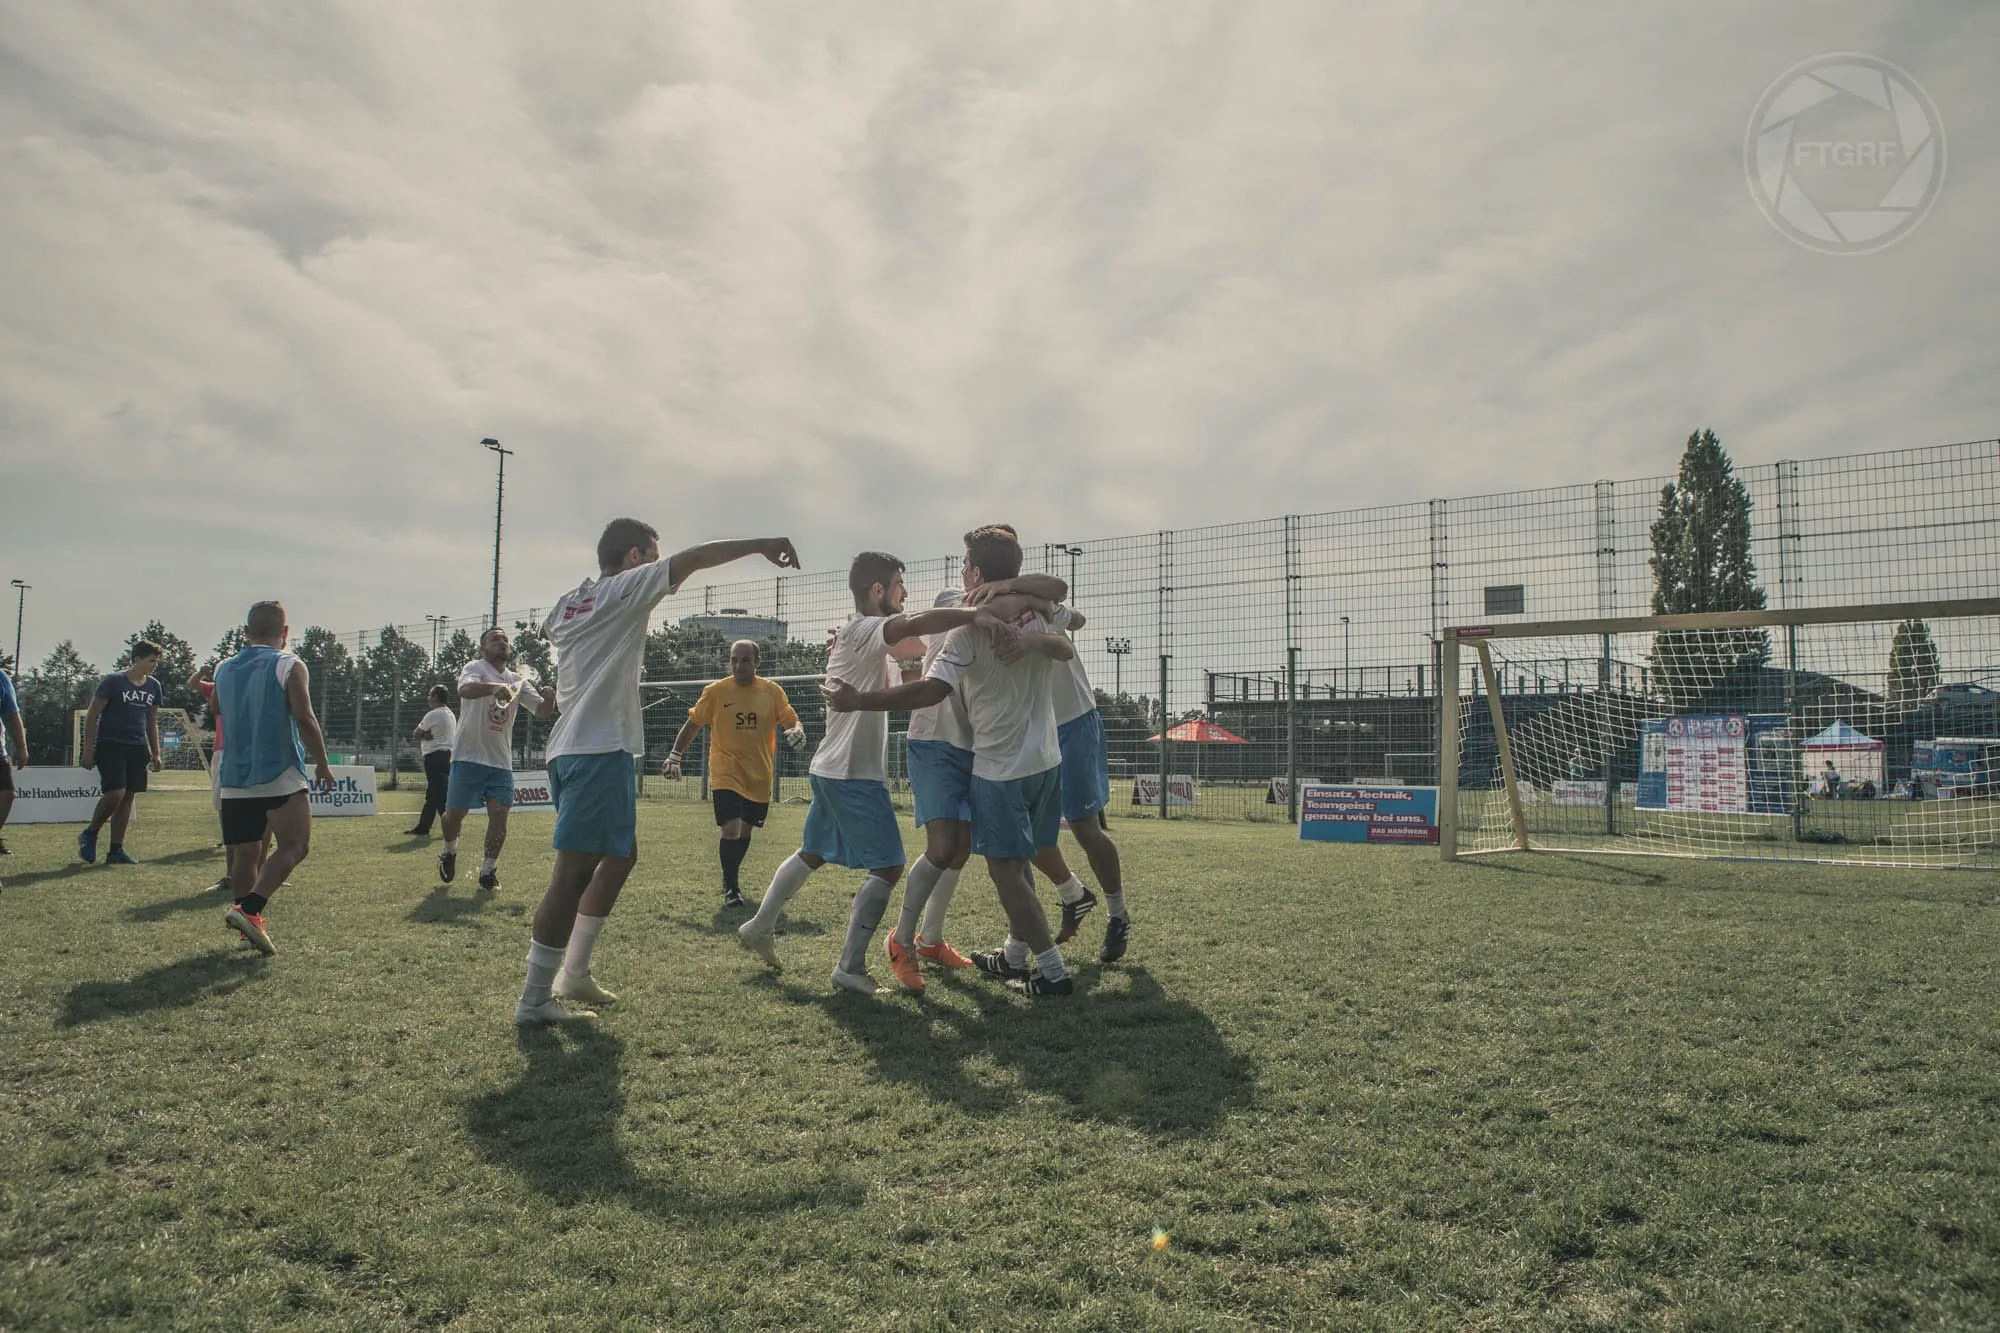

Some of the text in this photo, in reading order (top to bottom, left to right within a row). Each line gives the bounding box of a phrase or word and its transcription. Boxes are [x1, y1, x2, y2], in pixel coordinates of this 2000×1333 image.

[122, 690, 155, 706] KATE
[309, 789, 373, 807] magazin
[1305, 789, 1356, 799] Einsatz,
[1358, 789, 1412, 801] Technik,
[1305, 800, 1375, 811] Teamgeist:
[1304, 812, 1425, 823] genau wie bei uns.
